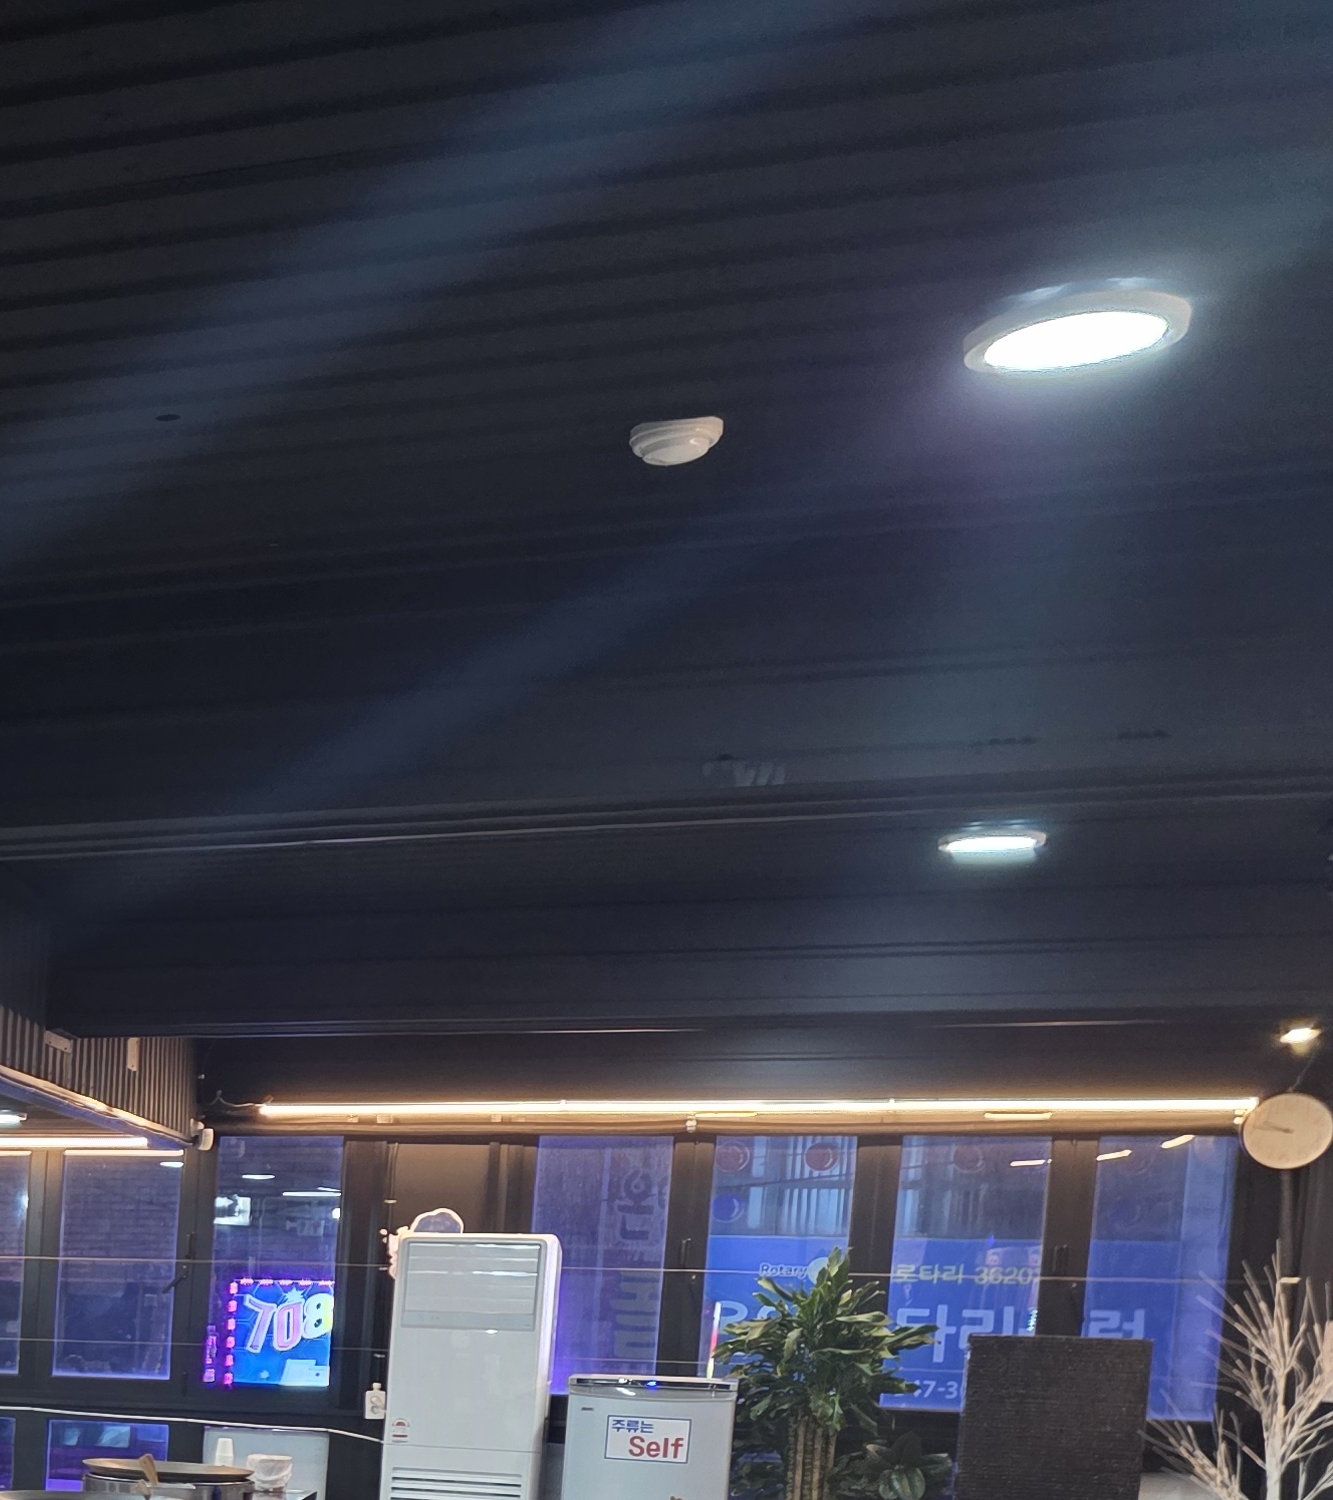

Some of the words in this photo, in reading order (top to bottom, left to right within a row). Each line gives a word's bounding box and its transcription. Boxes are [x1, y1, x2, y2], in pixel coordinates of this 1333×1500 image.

[759, 1263, 809, 1279] Rotary
[892, 1263, 965, 1285] 로타리
[244, 1293, 335, 1354] 708
[612, 1419, 654, 1433] 주류는
[628, 1436, 684, 1459] Self
